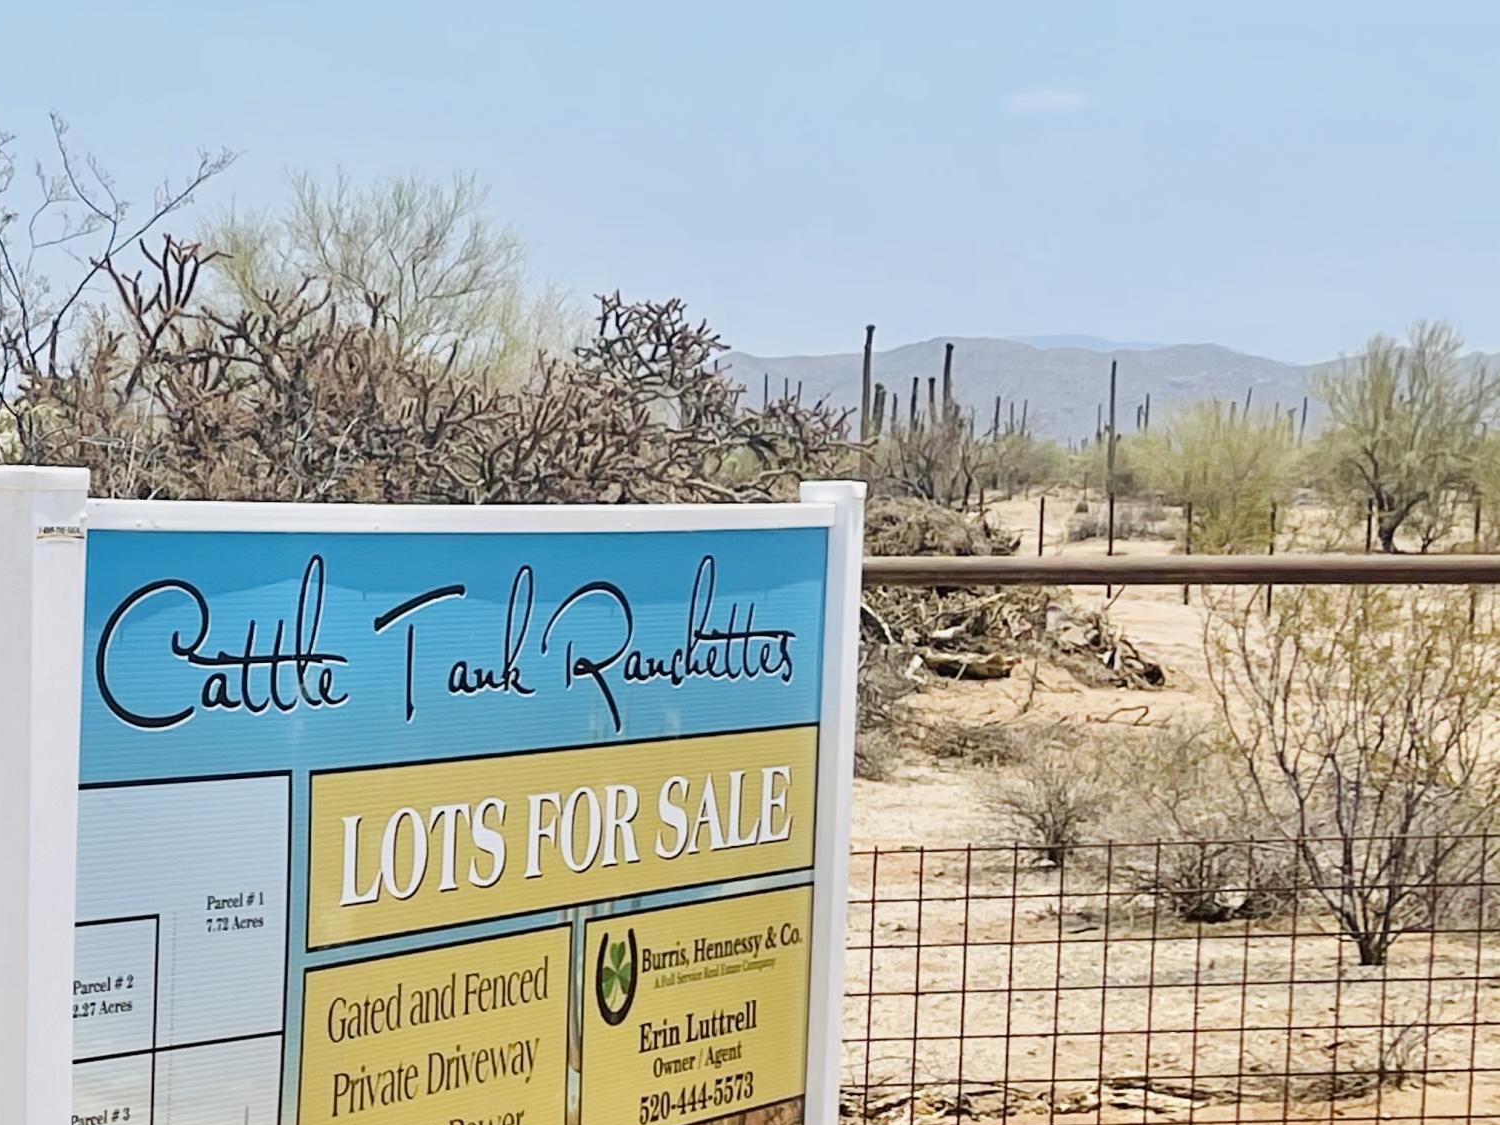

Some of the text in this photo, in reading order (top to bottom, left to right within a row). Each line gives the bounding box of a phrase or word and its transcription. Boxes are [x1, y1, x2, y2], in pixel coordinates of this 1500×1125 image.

[94, 553, 797, 735] Cattle Tank Ranchettes
[338, 766, 794, 908] LOTS FOR SALE
[206, 892, 243, 911] Parcel
[231, 916, 264, 931] Acres
[641, 923, 803, 973] Burris, Hennessy & Co.
[73, 976, 111, 995] Parcel
[126, 974, 134, 989] 2
[99, 1000, 133, 1015] Acres
[327, 955, 550, 1043] Gated and Fenced
[638, 1000, 758, 1053] Erin Luttrell
[331, 1037, 541, 1117] Private Driveway
[652, 1054, 696, 1078] Owner
[705, 1043, 742, 1070] Agent
[122, 1107, 131, 1121] 3
[639, 1071, 754, 1125] 520-444-5573
